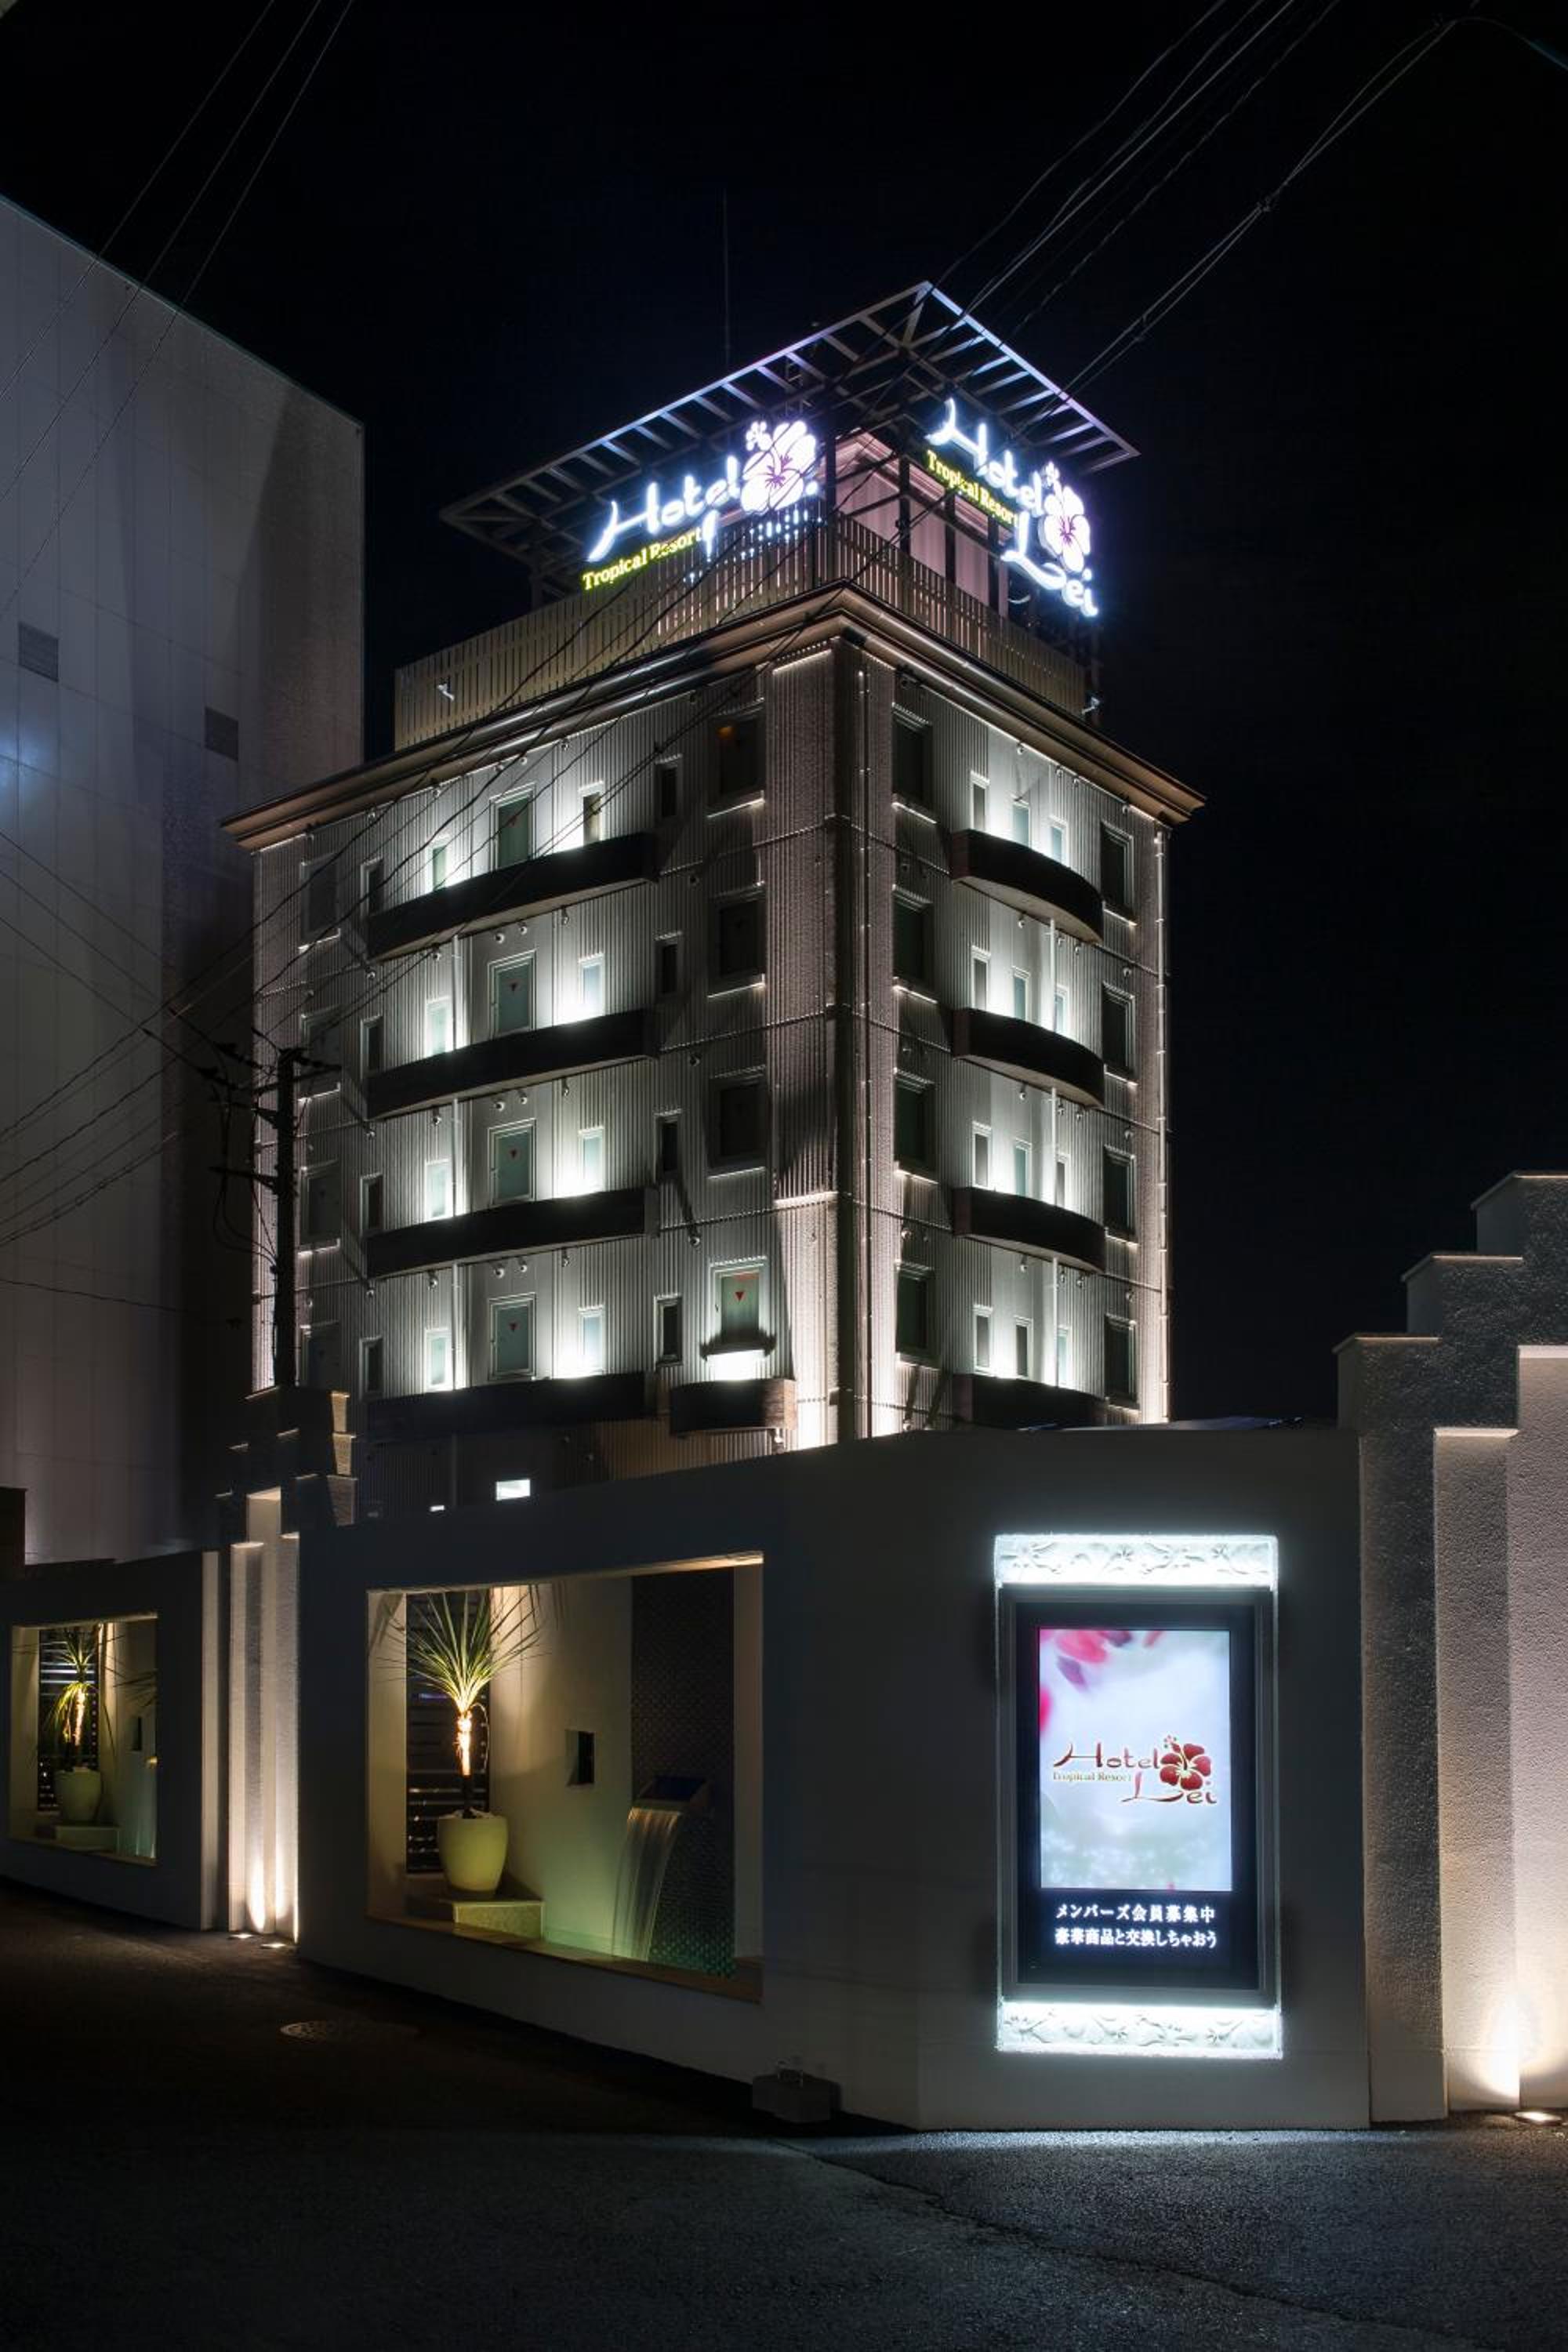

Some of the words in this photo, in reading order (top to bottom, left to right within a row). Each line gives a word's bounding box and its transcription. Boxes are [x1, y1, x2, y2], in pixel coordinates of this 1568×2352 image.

[924, 397, 1044, 517] Hotel
[927, 449, 979, 502] Tropical
[586, 455, 740, 562] Hotel
[583, 546, 648, 590] Tropical
[649, 526, 703, 559] Resort
[1053, 1742, 1160, 1769] Hotel
[1121, 1771, 1218, 1804] Lei
[1056, 1904, 1215, 1923] メンバーズ会員募集中
[1054, 1926, 1218, 1948] 豪華商品と交換しちゃおう
